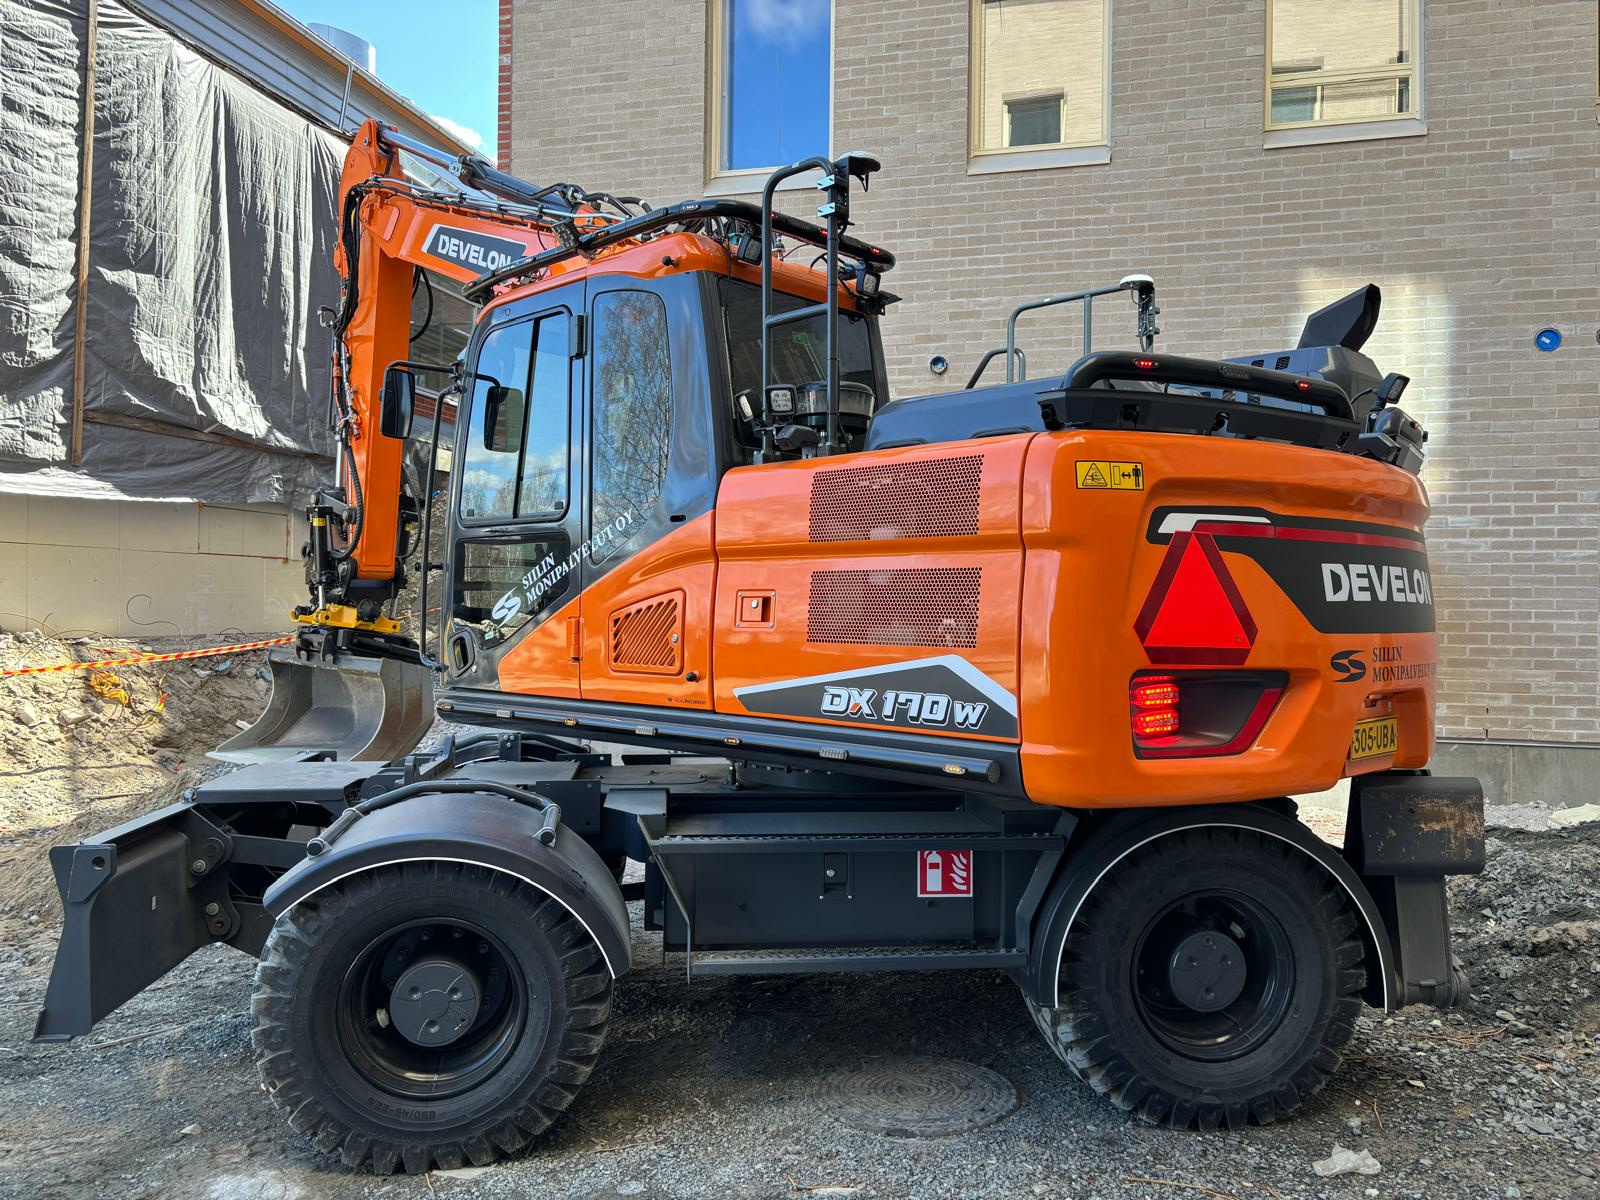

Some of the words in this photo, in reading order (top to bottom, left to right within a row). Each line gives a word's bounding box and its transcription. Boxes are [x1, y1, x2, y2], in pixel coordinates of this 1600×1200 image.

[437, 234, 512, 270] DEVELON
[615, 508, 635, 531] OY
[522, 552, 555, 590] SIILIN
[1321, 563, 1432, 605] DEVELON
[1372, 647, 1402, 662] SIILIN
[820, 686, 877, 719] DX
